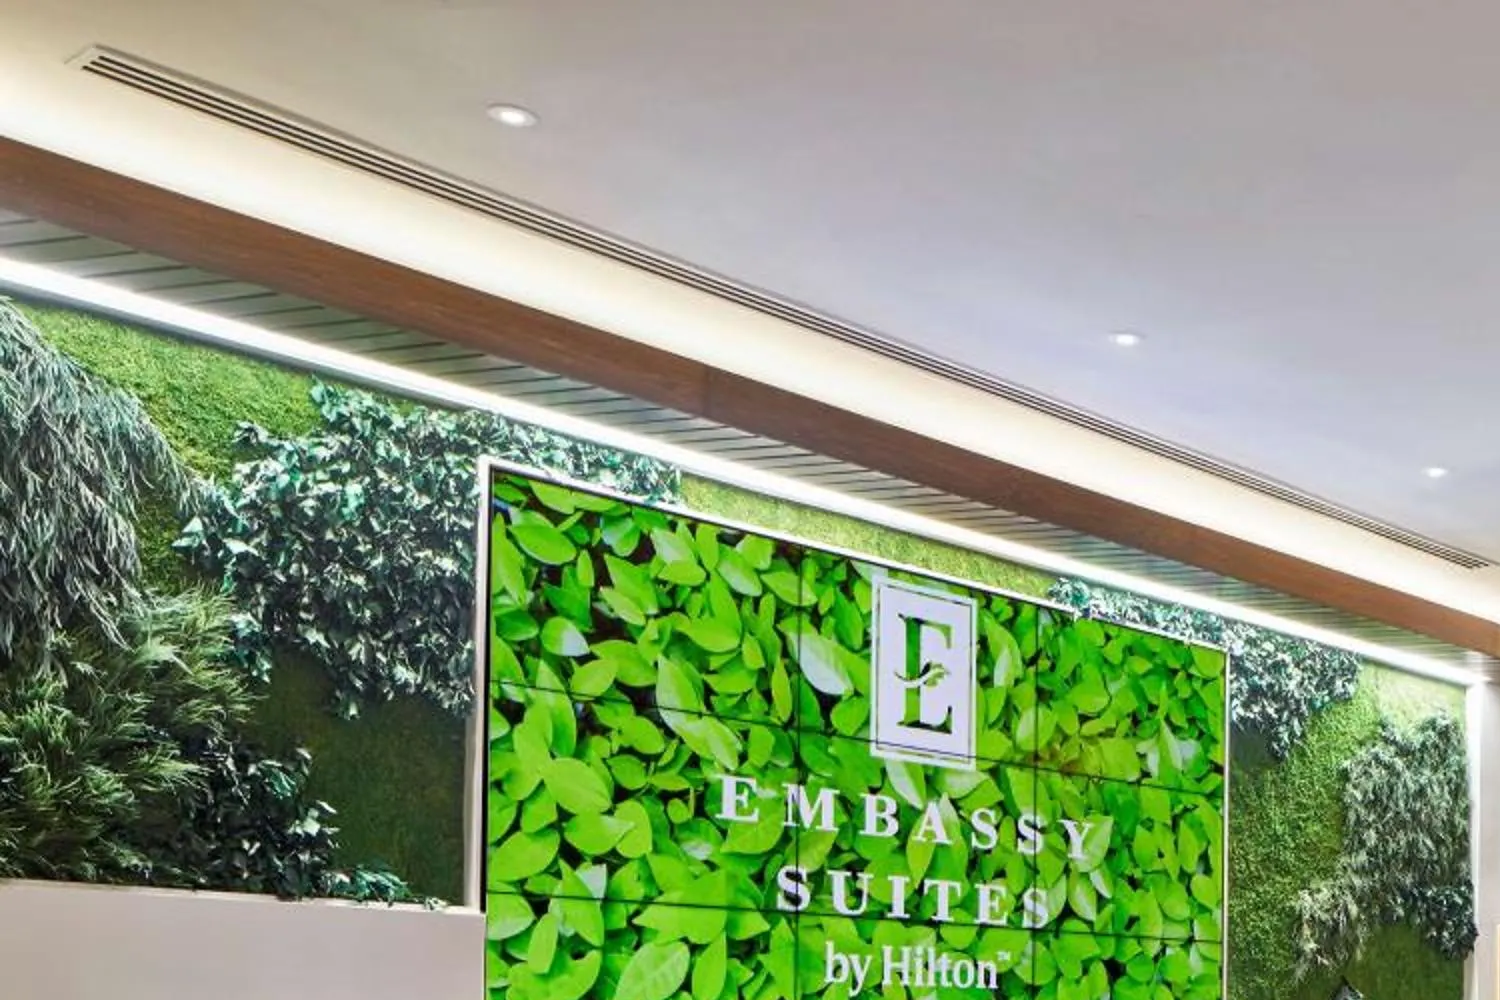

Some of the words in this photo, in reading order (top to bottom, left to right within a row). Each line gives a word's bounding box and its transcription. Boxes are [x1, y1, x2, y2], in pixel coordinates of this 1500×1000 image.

[715, 773, 1094, 860] EMBASSY
[776, 864, 1049, 928] SUITES
[825, 940, 872, 997] by
